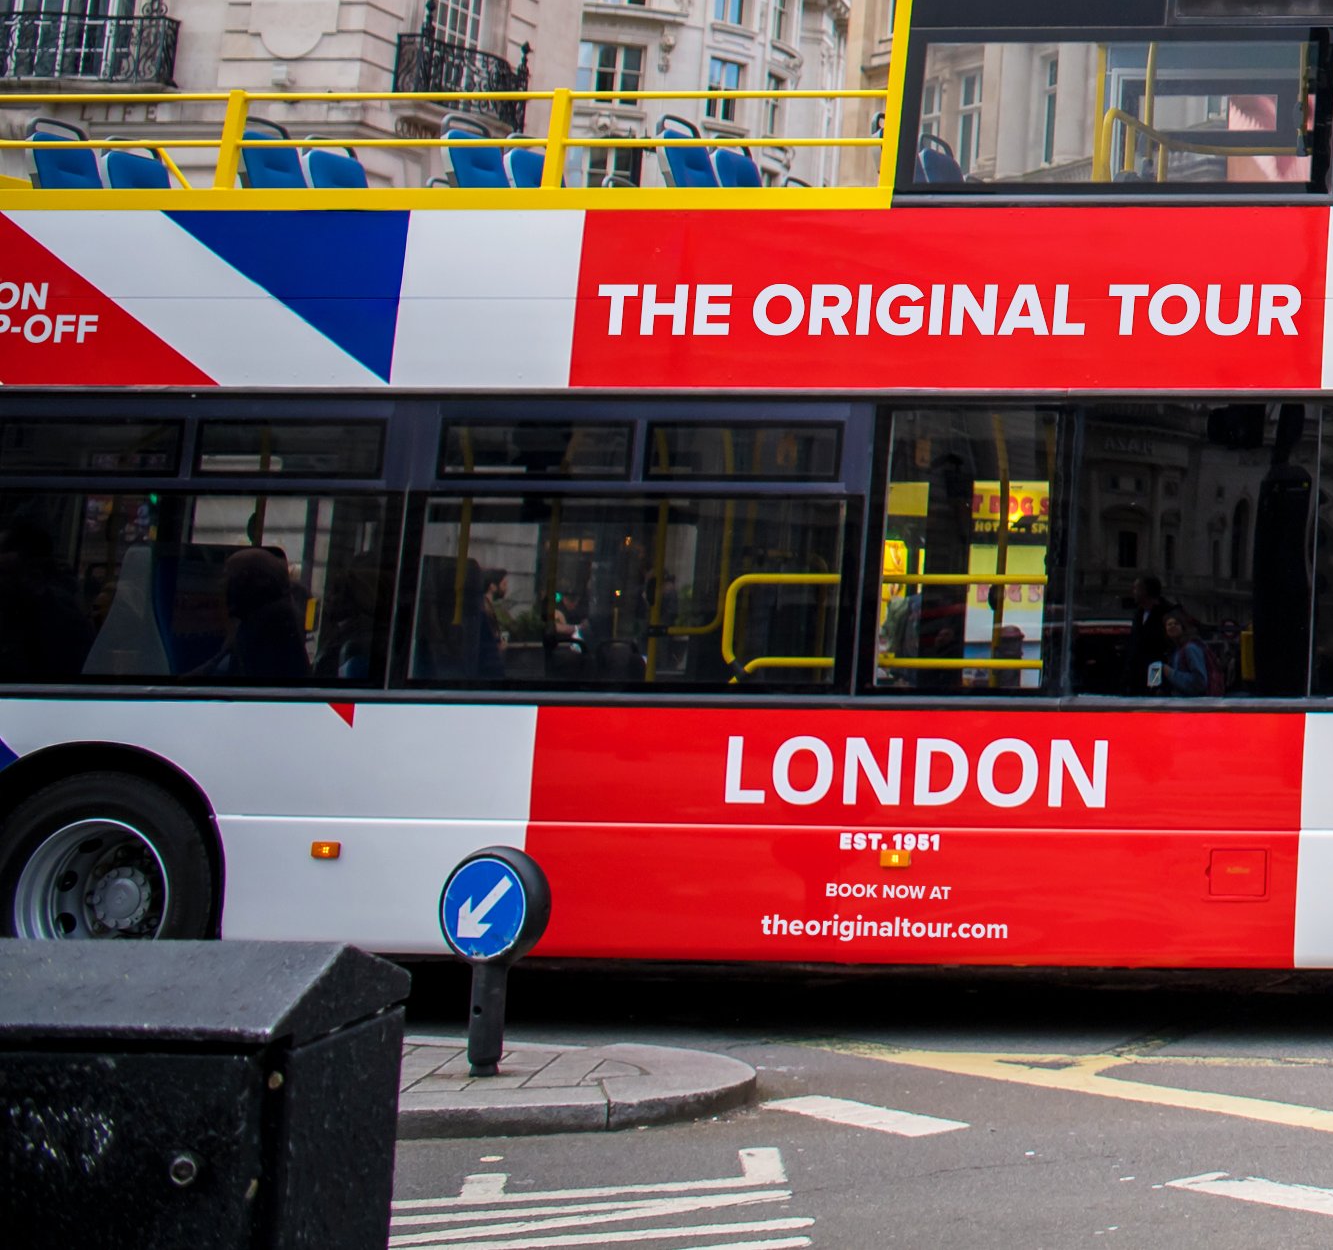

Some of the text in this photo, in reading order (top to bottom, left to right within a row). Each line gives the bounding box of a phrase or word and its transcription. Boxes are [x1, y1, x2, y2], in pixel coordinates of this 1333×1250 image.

[0, 281, 49, 310] ON
[598, 283, 1301, 336] THE ORIGINAL TOUR
[724, 734, 1109, 809] LONDON
[839, 833, 940, 851] EST. 1951
[825, 882, 952, 901] BOOK NOW AT
[761, 914, 1009, 942] theoriginaltour.com
